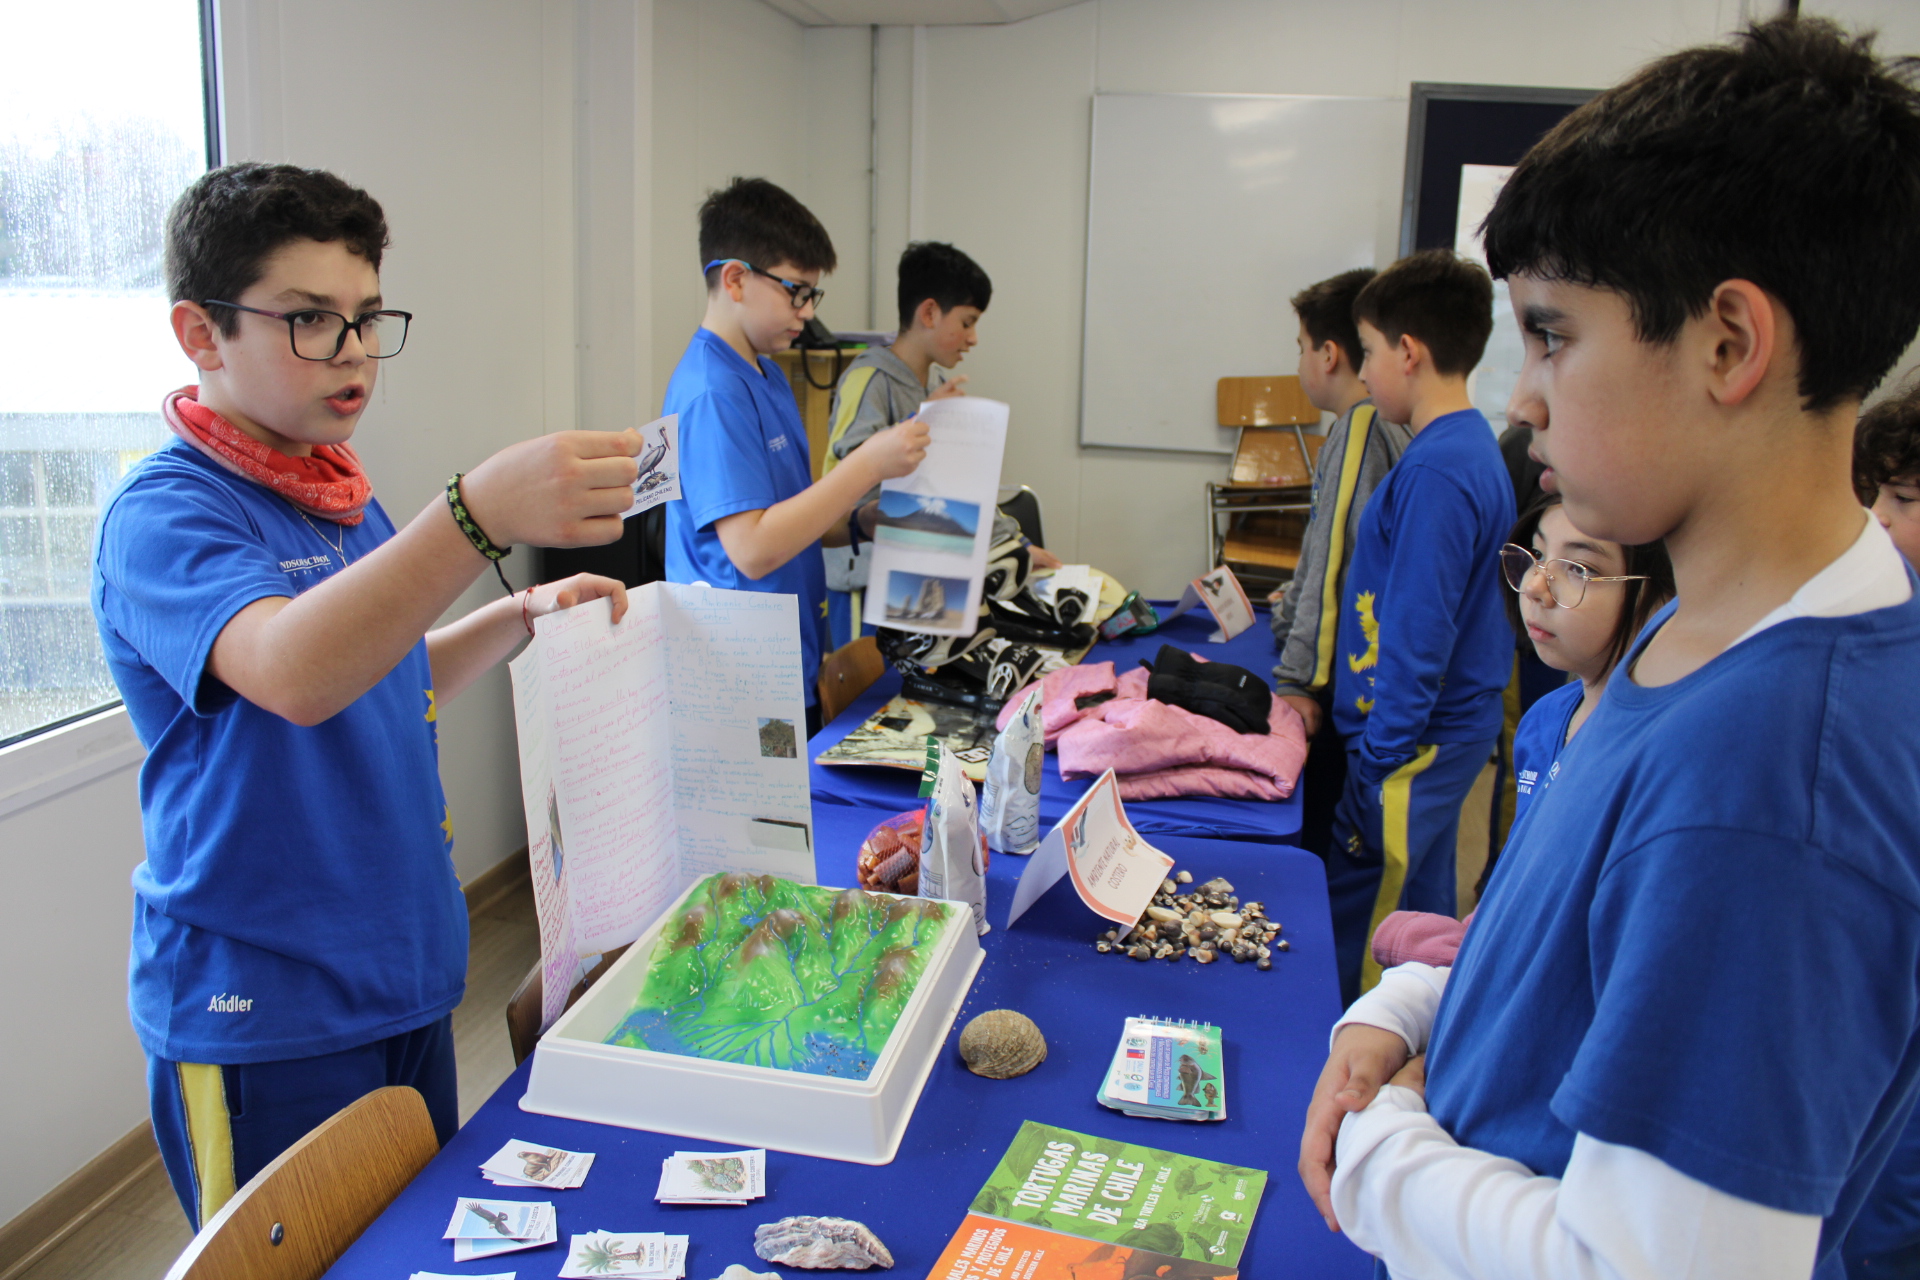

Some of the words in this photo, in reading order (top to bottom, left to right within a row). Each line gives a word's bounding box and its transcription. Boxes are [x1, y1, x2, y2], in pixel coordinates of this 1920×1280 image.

[654, 486, 672, 498] CHILENO
[1086, 855, 1108, 888] AMBIENTE
[1103, 836, 1121, 863] NATURAL
[1108, 862, 1128, 890] COSTERO
[207, 992, 253, 1012] Andler
[1012, 1141, 1076, 1208] TORTUGAS
[1050, 1151, 1110, 1216] MARINAS
[1101, 1158, 1144, 1201] CHILE
[1155, 1166, 1172, 1184] CHILE
[1150, 1184, 1164, 1193] OF
[531, 1206, 540, 1220] COSTA
[1086, 1203, 1122, 1226] DE
[1140, 1193, 1160, 1218] TURTLES
[1134, 1218, 1148, 1230] SEA
[960, 1228, 990, 1259] MARINOS
[975, 1228, 1008, 1266] PROTEGIDOS
[993, 1246, 1014, 1266] CHILE
[1014, 1250, 1032, 1272] PROTECTED
[1022, 1260, 1040, 1280] SOUTHERN
[1034, 1249, 1046, 1261] CHILE
[986, 1266, 1002, 1278] DE
